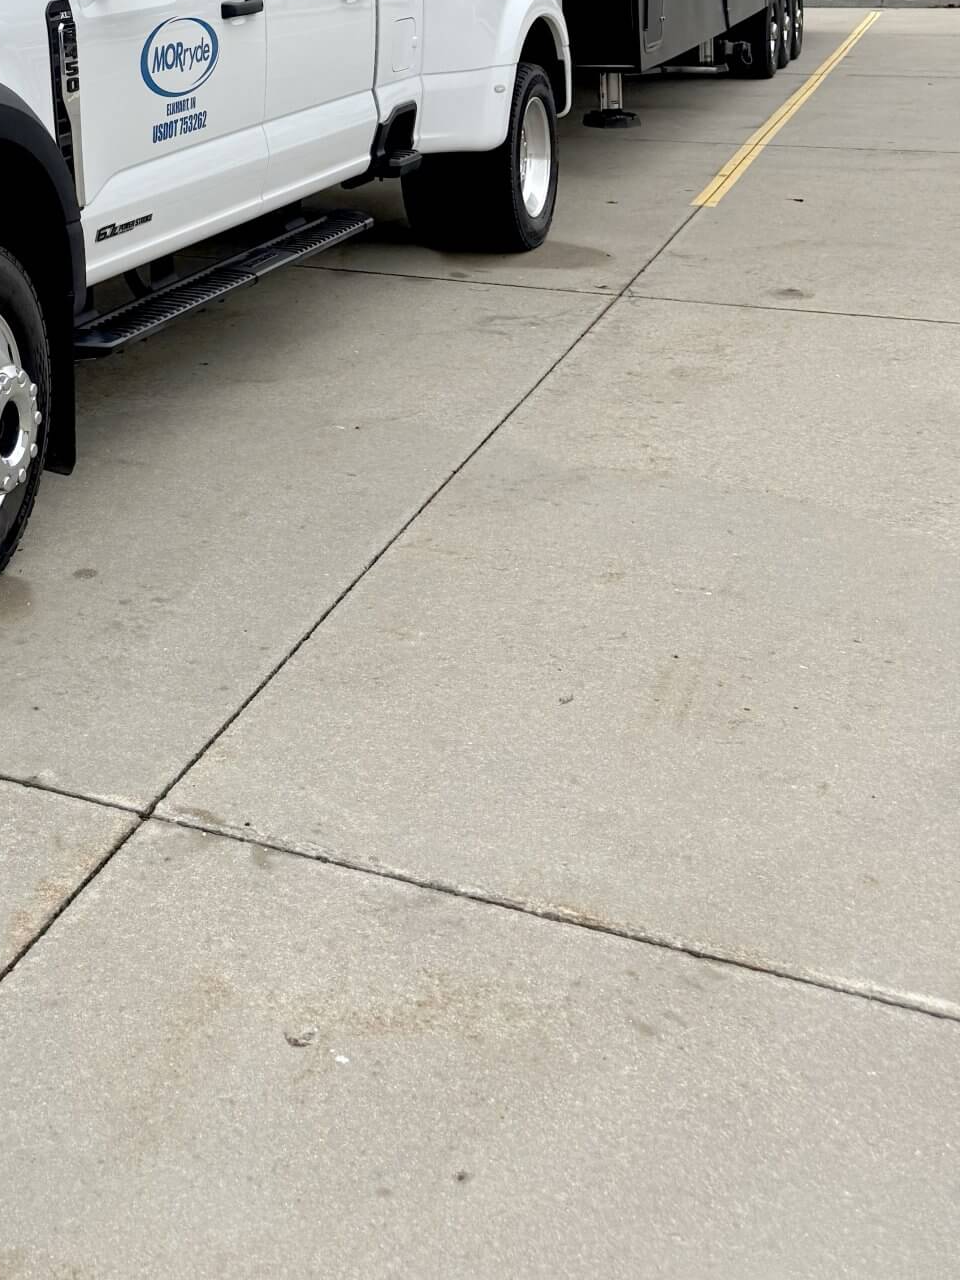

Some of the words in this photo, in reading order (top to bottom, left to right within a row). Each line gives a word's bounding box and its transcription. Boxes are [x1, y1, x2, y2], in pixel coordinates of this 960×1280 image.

[152, 36, 210, 73] MORryde
[152, 118, 178, 143] USDOT
[179, 110, 208, 135] 753262
